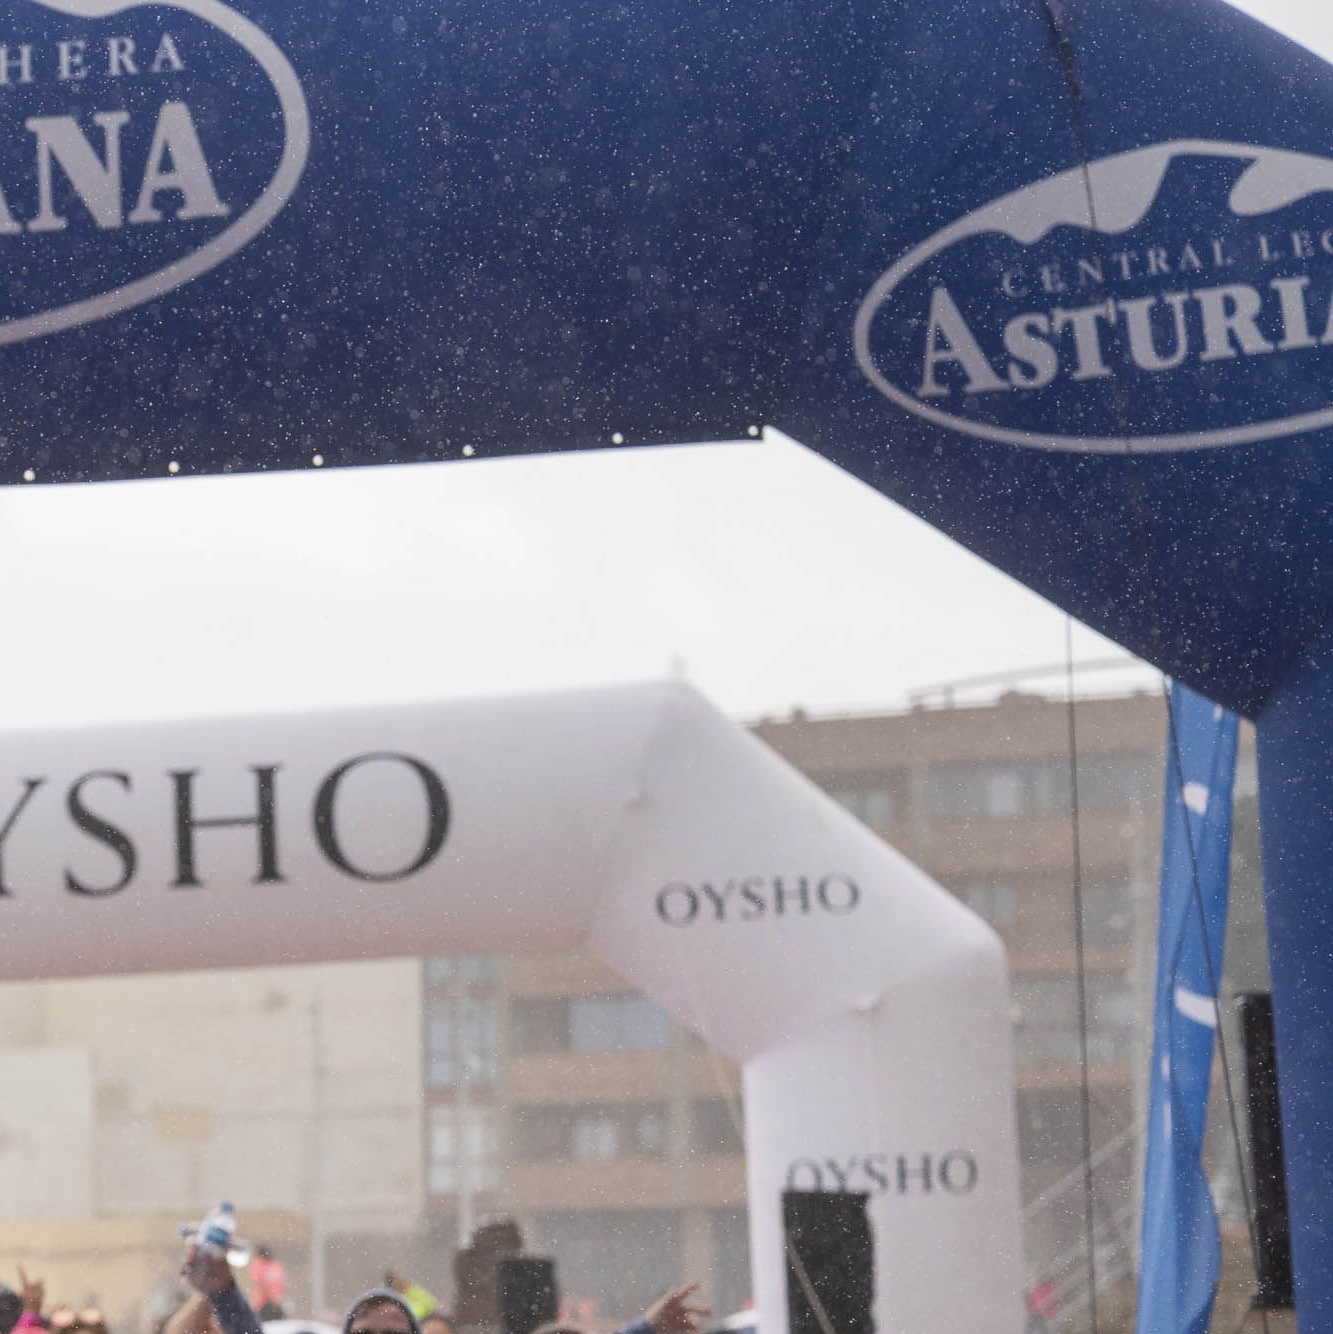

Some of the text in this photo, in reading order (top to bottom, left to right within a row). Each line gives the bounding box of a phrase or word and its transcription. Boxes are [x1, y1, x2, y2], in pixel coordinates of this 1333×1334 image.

[1002, 238, 1235, 298] CENTRAL
[917, 275, 1333, 399] ASTURI
[655, 871, 863, 929] OYSHO
